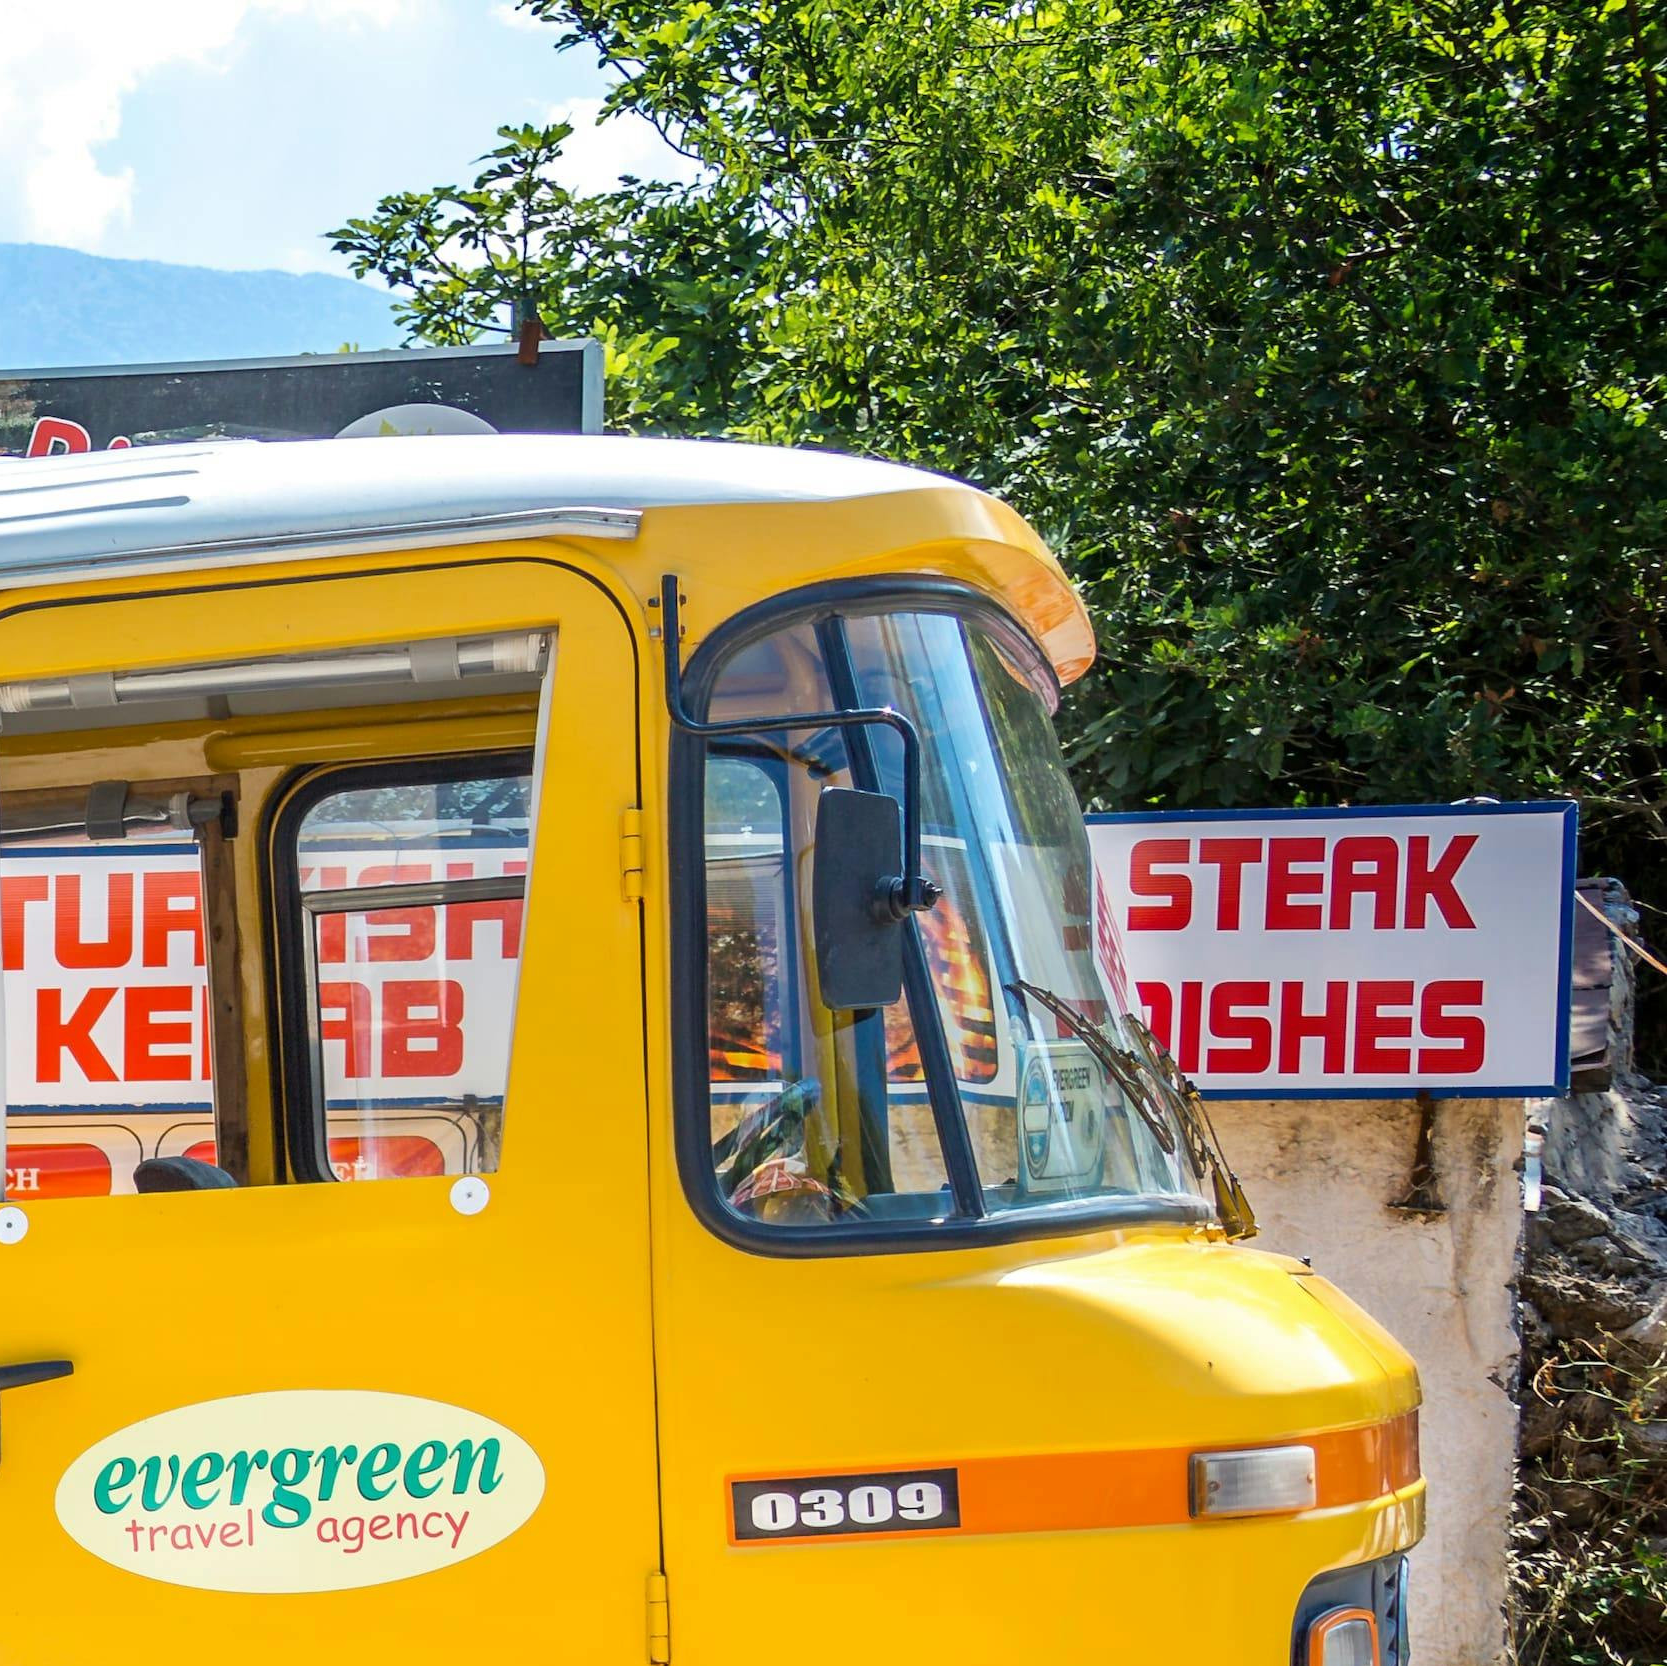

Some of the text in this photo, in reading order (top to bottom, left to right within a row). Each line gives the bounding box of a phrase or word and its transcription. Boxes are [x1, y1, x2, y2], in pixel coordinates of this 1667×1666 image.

[0, 860, 524, 971] TURISH
[1128, 835, 1479, 931] STEAK
[35, 979, 464, 1084] KEAB
[93, 1435, 504, 1530] evergreen
[751, 1480, 946, 1530] 0309
[125, 1506, 470, 1555] travel agency
